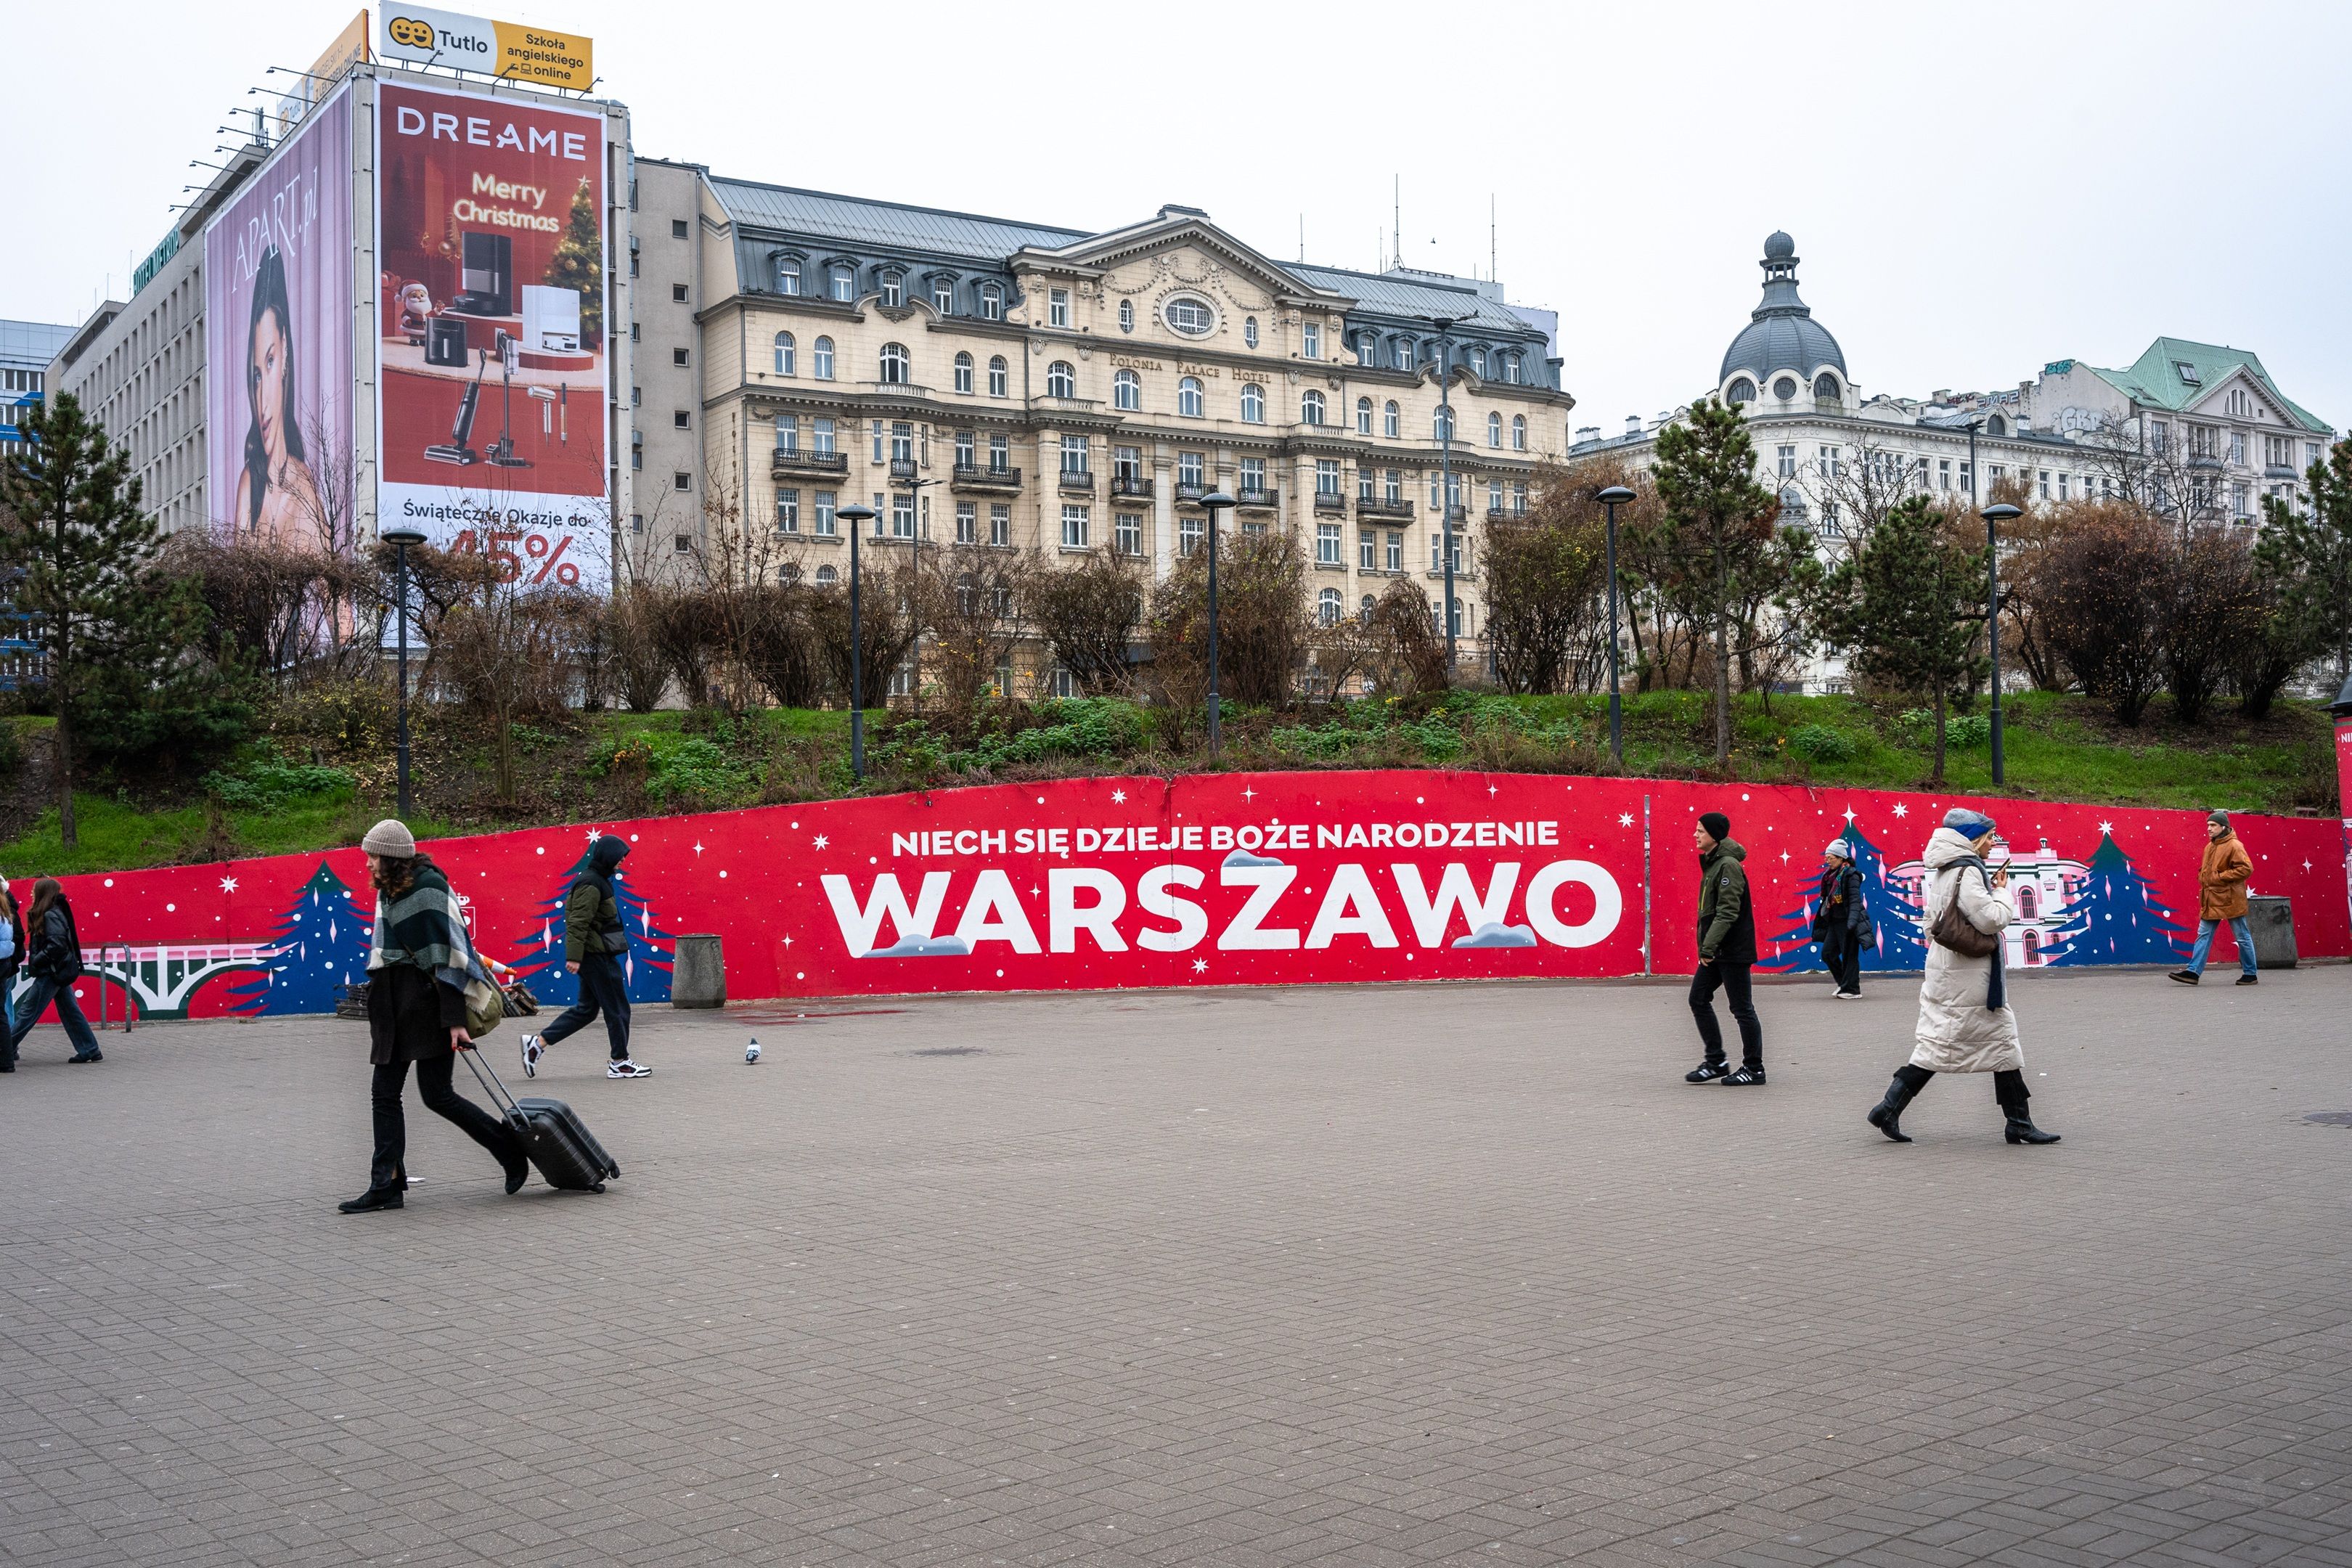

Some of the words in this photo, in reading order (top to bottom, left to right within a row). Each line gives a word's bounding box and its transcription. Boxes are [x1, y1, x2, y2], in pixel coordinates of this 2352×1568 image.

[438, 30, 489, 54] Tutlo
[507, 46, 584, 68] angielskiego
[526, 33, 565, 50] Szkoła
[534, 65, 572, 80] online
[290, 100, 301, 118] Tutlo
[398, 106, 586, 161] DREAME
[472, 171, 547, 210] Merry
[232, 166, 318, 293] APART.pl
[453, 198, 560, 233] Christmas
[1109, 353, 1163, 371] POLONIA
[1175, 360, 1220, 377] PALACE
[1231, 367, 1272, 383] HOTEL
[404, 498, 501, 522] Świąteczne
[507, 509, 563, 529] Okazje
[568, 513, 588, 527] do
[892, 829, 1007, 857] NIECH
[1014, 826, 1070, 859] SIĘ
[1077, 826, 1204, 852] DZIEJE
[1211, 819, 1309, 850] BOŻE
[1318, 821, 1559, 848] NARODZENIE
[820, 859, 1622, 958] WARSZAWO
